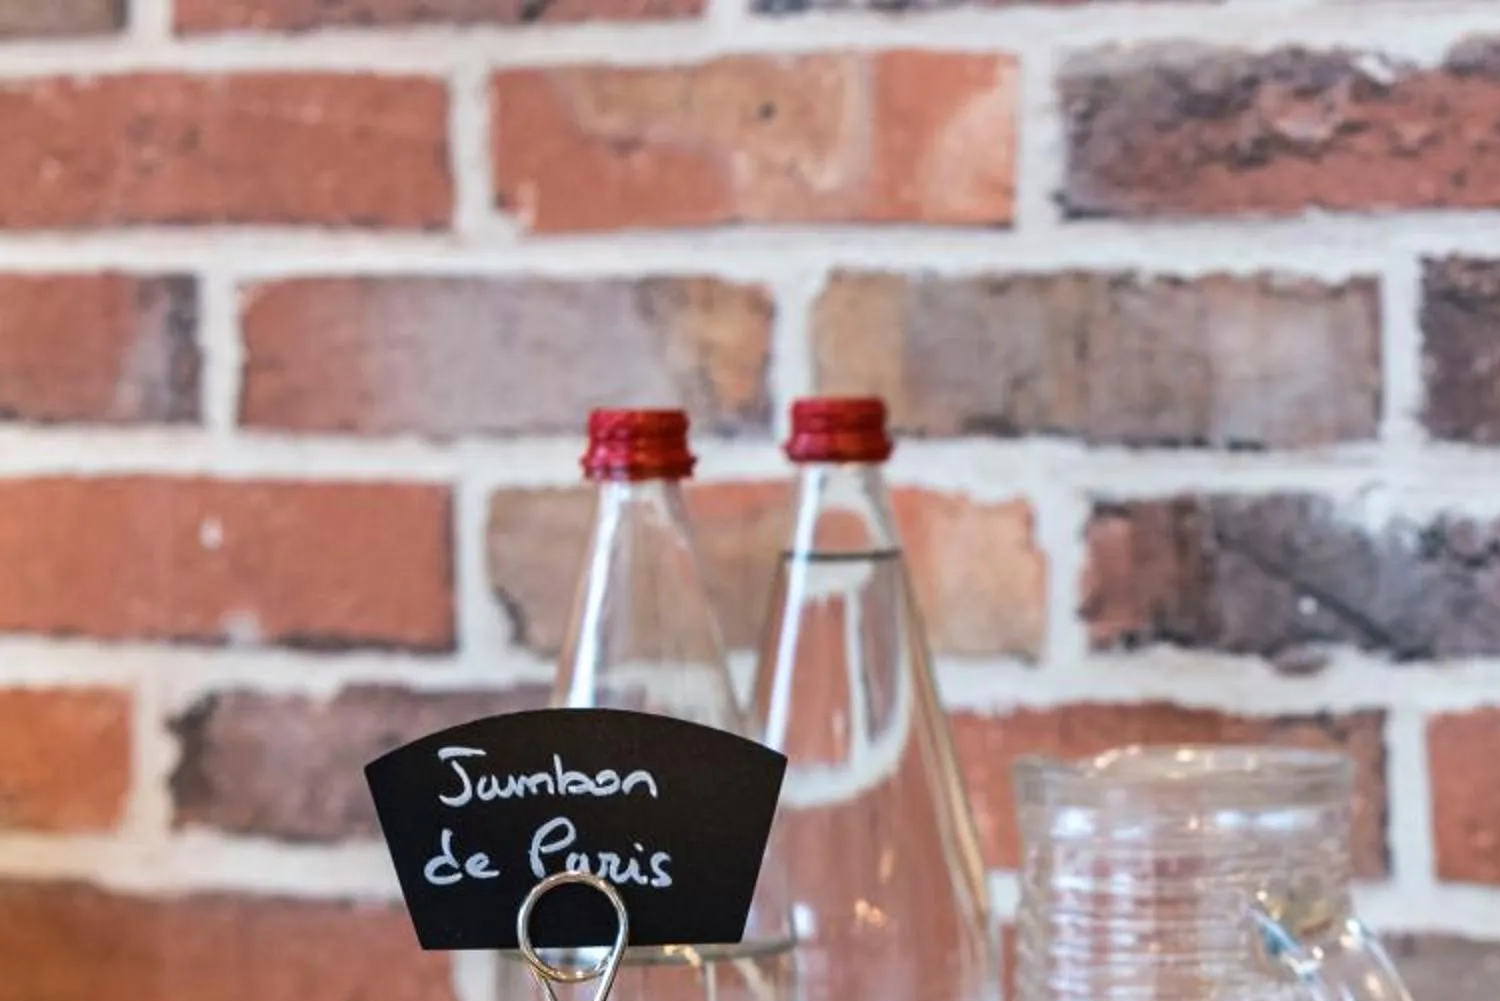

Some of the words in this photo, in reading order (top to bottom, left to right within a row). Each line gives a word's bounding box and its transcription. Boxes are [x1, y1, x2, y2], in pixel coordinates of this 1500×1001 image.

[437, 746, 658, 808] Jambon
[423, 828, 500, 886] de
[528, 816, 674, 888] Paris
